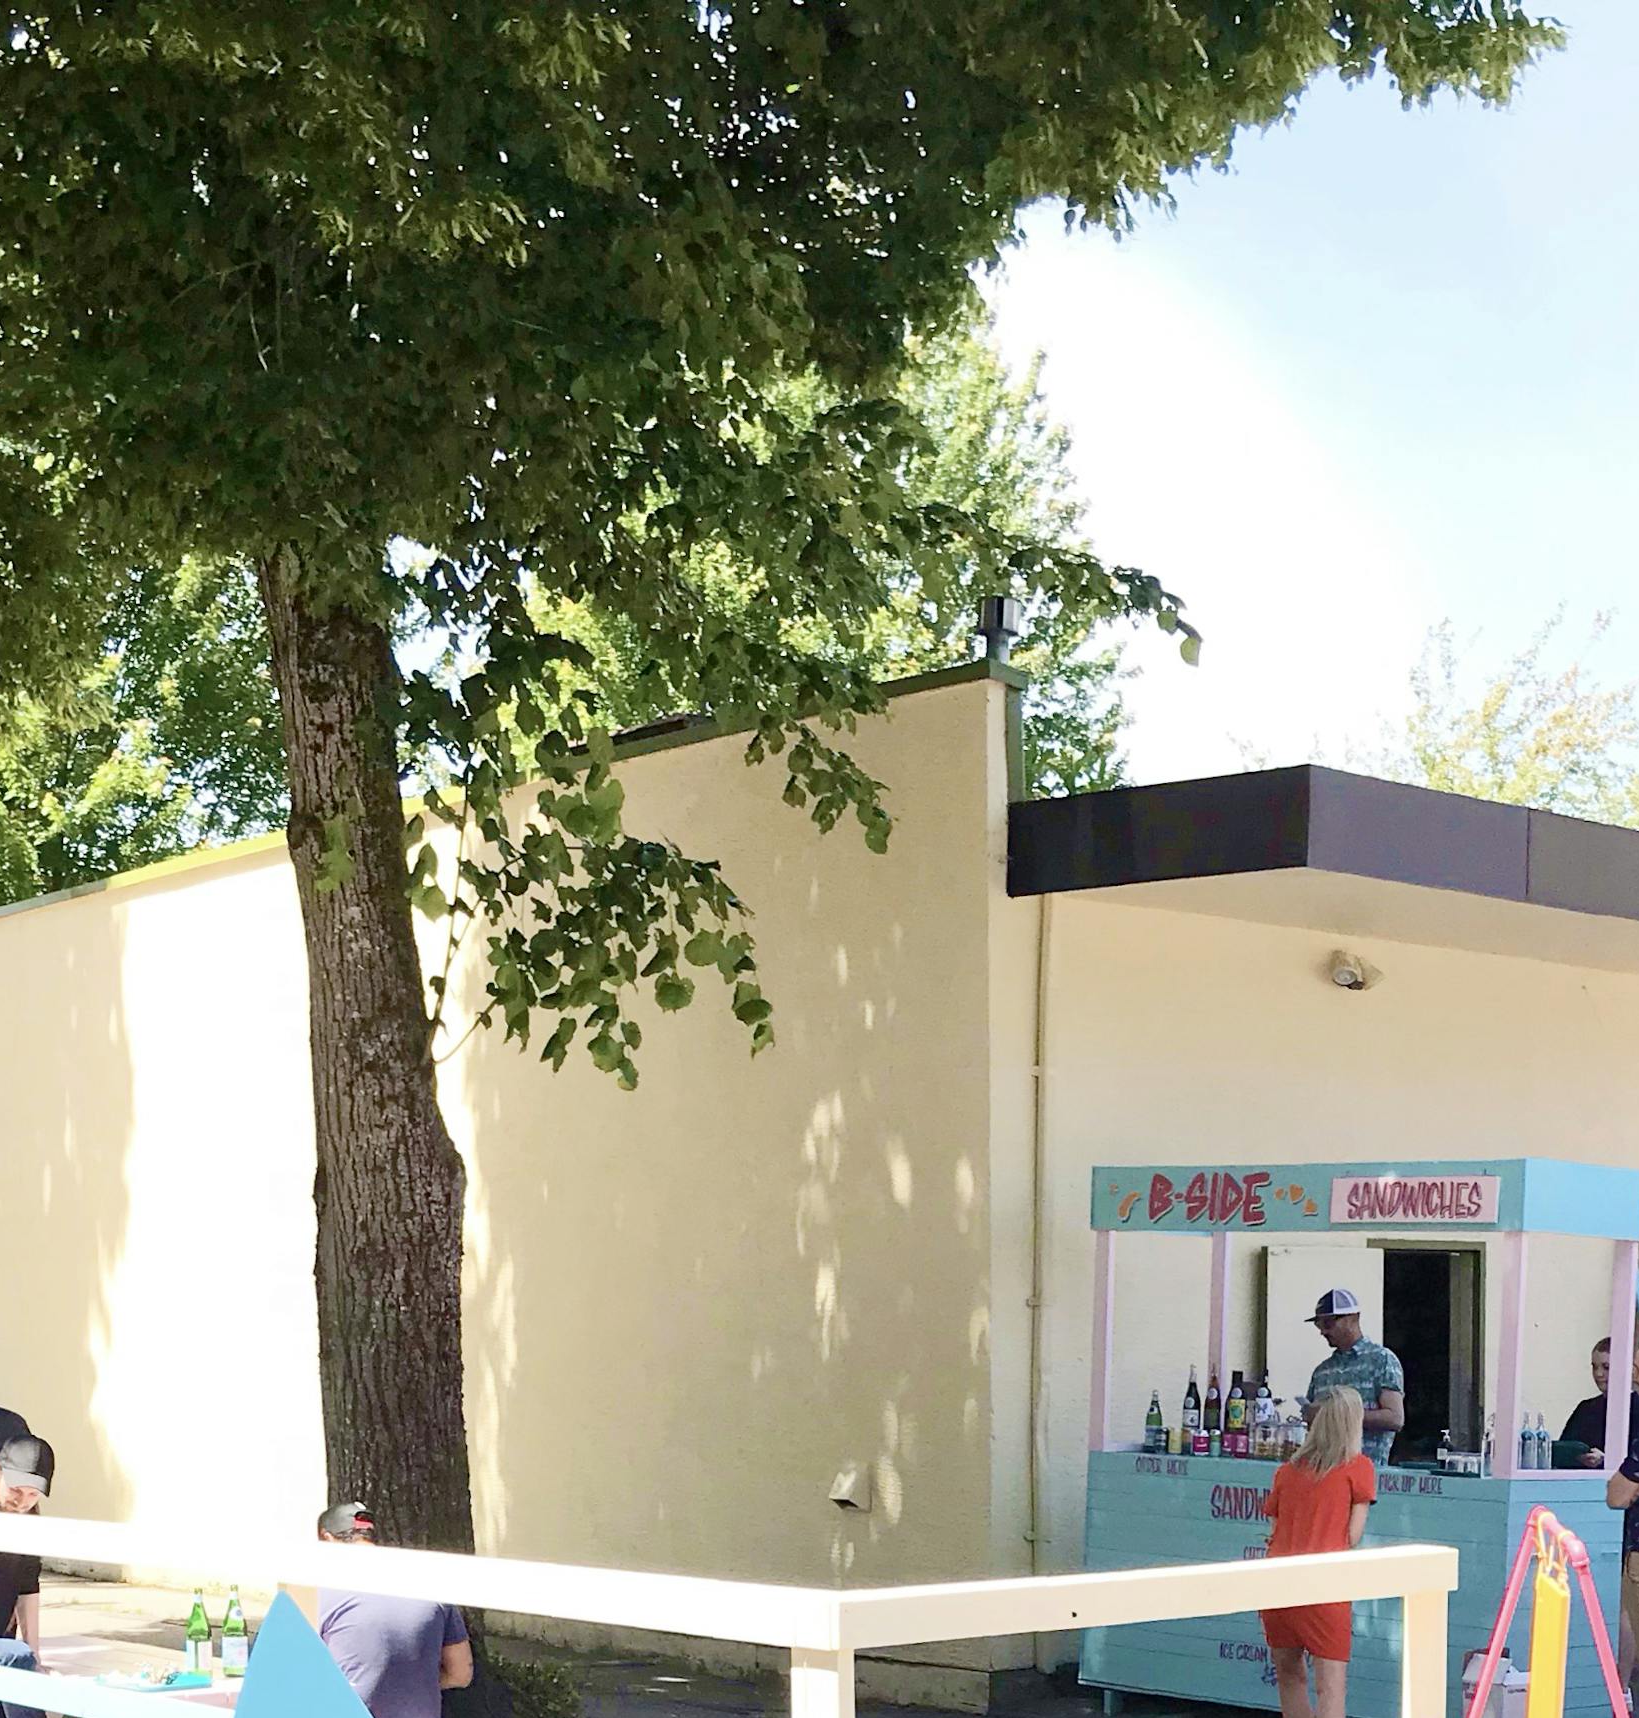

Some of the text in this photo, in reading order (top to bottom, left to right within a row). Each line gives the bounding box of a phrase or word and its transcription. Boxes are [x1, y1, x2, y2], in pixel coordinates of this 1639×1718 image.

[1147, 1172, 1271, 1226] B-SIDE
[1347, 1181, 1483, 1220] SANDWICHES
[1401, 1475, 1415, 1492] UP
[1419, 1476, 1443, 1494] HERE
